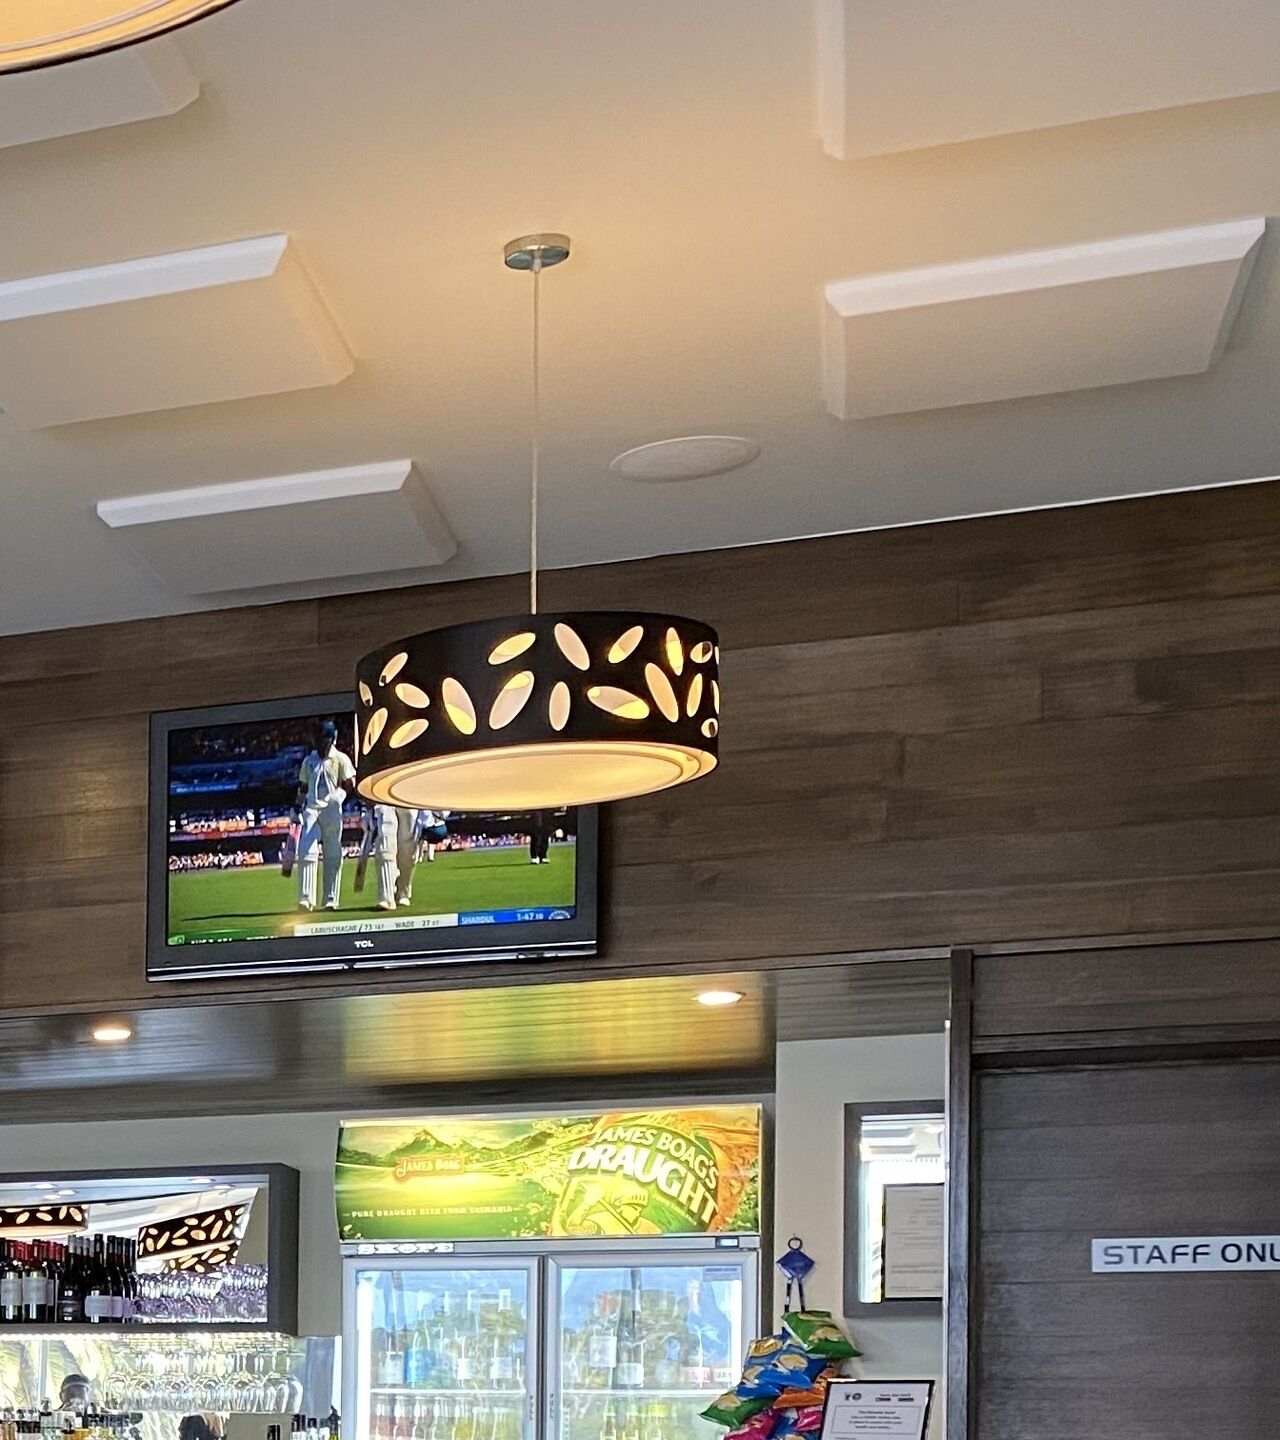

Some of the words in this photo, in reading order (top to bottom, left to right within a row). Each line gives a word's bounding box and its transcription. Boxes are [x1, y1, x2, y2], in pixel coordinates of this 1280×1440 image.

[395, 921, 415, 929] WADE
[354, 940, 374, 949] TCL
[396, 1158, 433, 1177] JAMES
[590, 1126, 658, 1146] JAMES
[656, 1132, 720, 1190] BOAG'S
[567, 1144, 720, 1224] DRAUGHT
[351, 1210, 373, 1218] PURE
[377, 1209, 416, 1217] DRAUGHT
[1104, 1244, 1211, 1265] STAFF
